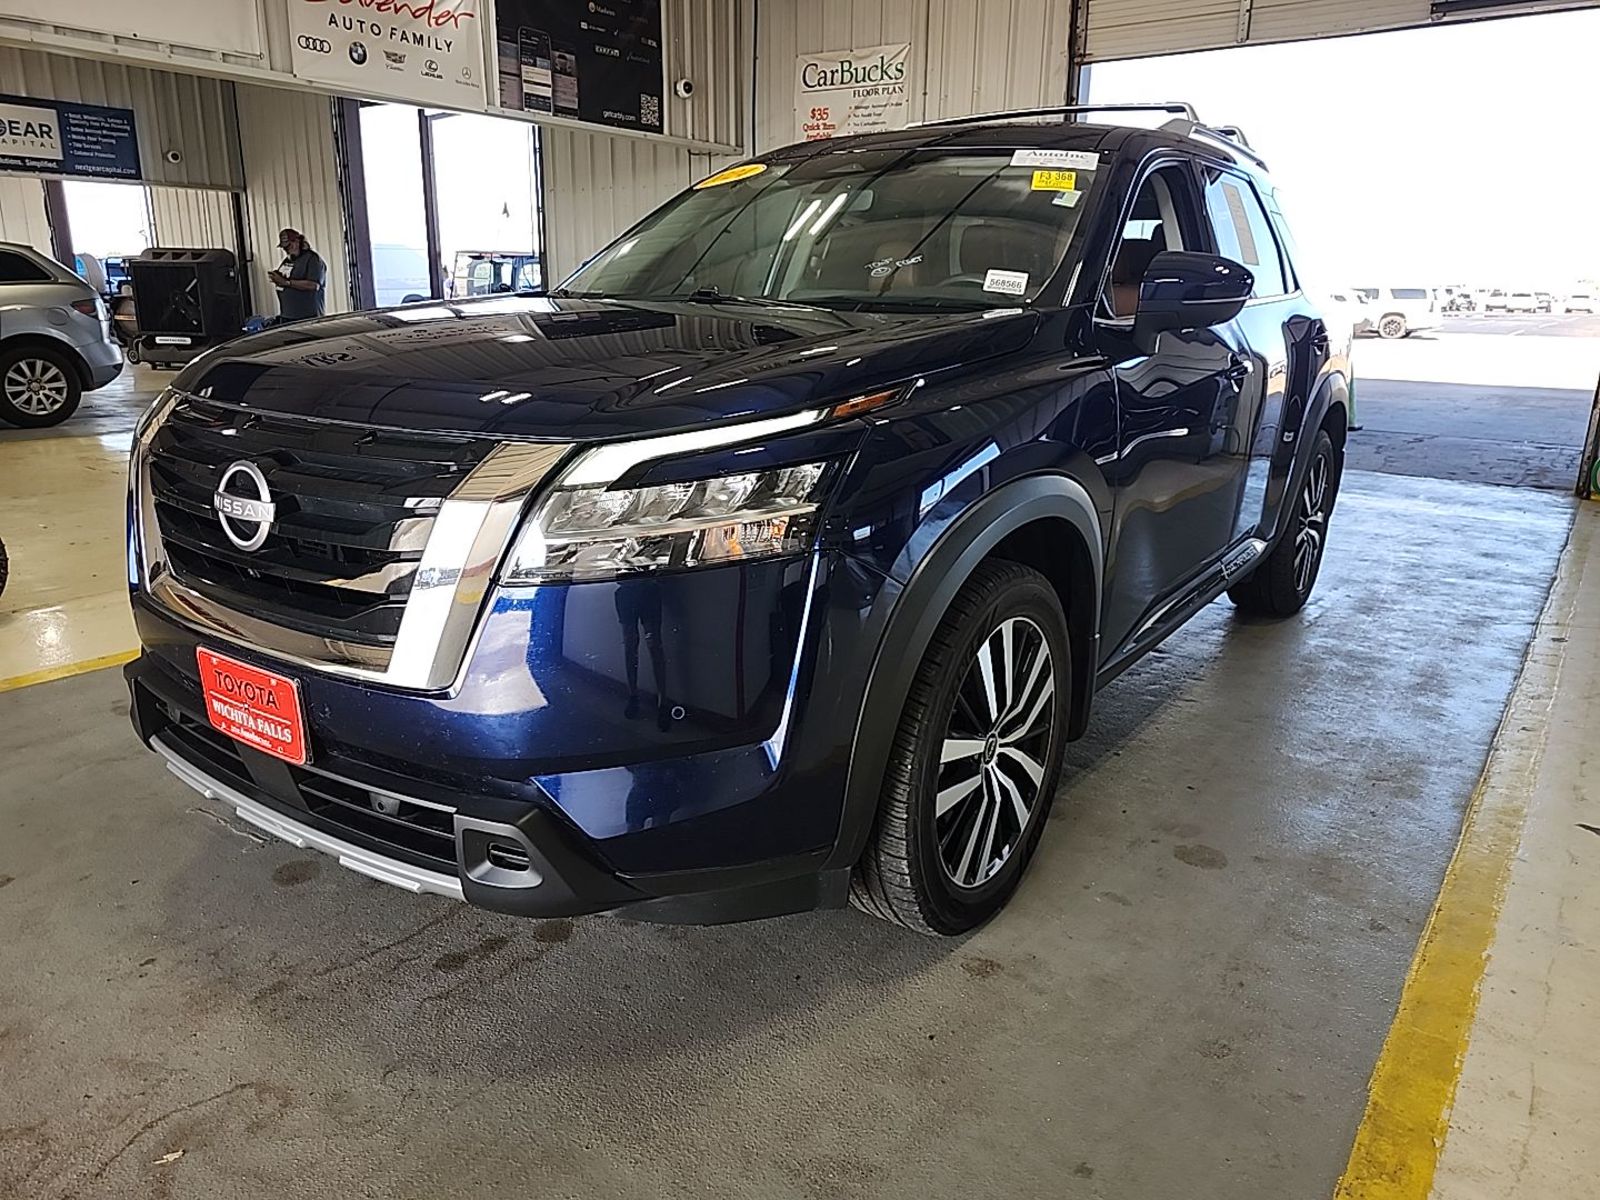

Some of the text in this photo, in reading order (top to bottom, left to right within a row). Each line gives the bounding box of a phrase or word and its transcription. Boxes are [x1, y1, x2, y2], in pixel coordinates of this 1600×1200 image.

[328, 13, 454, 53] AUTO FAMILY
[802, 55, 905, 89] CarBucks
[852, 85, 905, 98] FLOOR PLAN
[810, 107, 829, 121] $35
[803, 123, 821, 133] Quick
[1, 138, 56, 149] APITAL
[1040, 172, 1073, 181] F3 368
[214, 493, 272, 518] NISSAN
[214, 669, 280, 711] TOYOTA
[212, 699, 257, 730] WICHITA
[257, 718, 293, 743] FALLS
